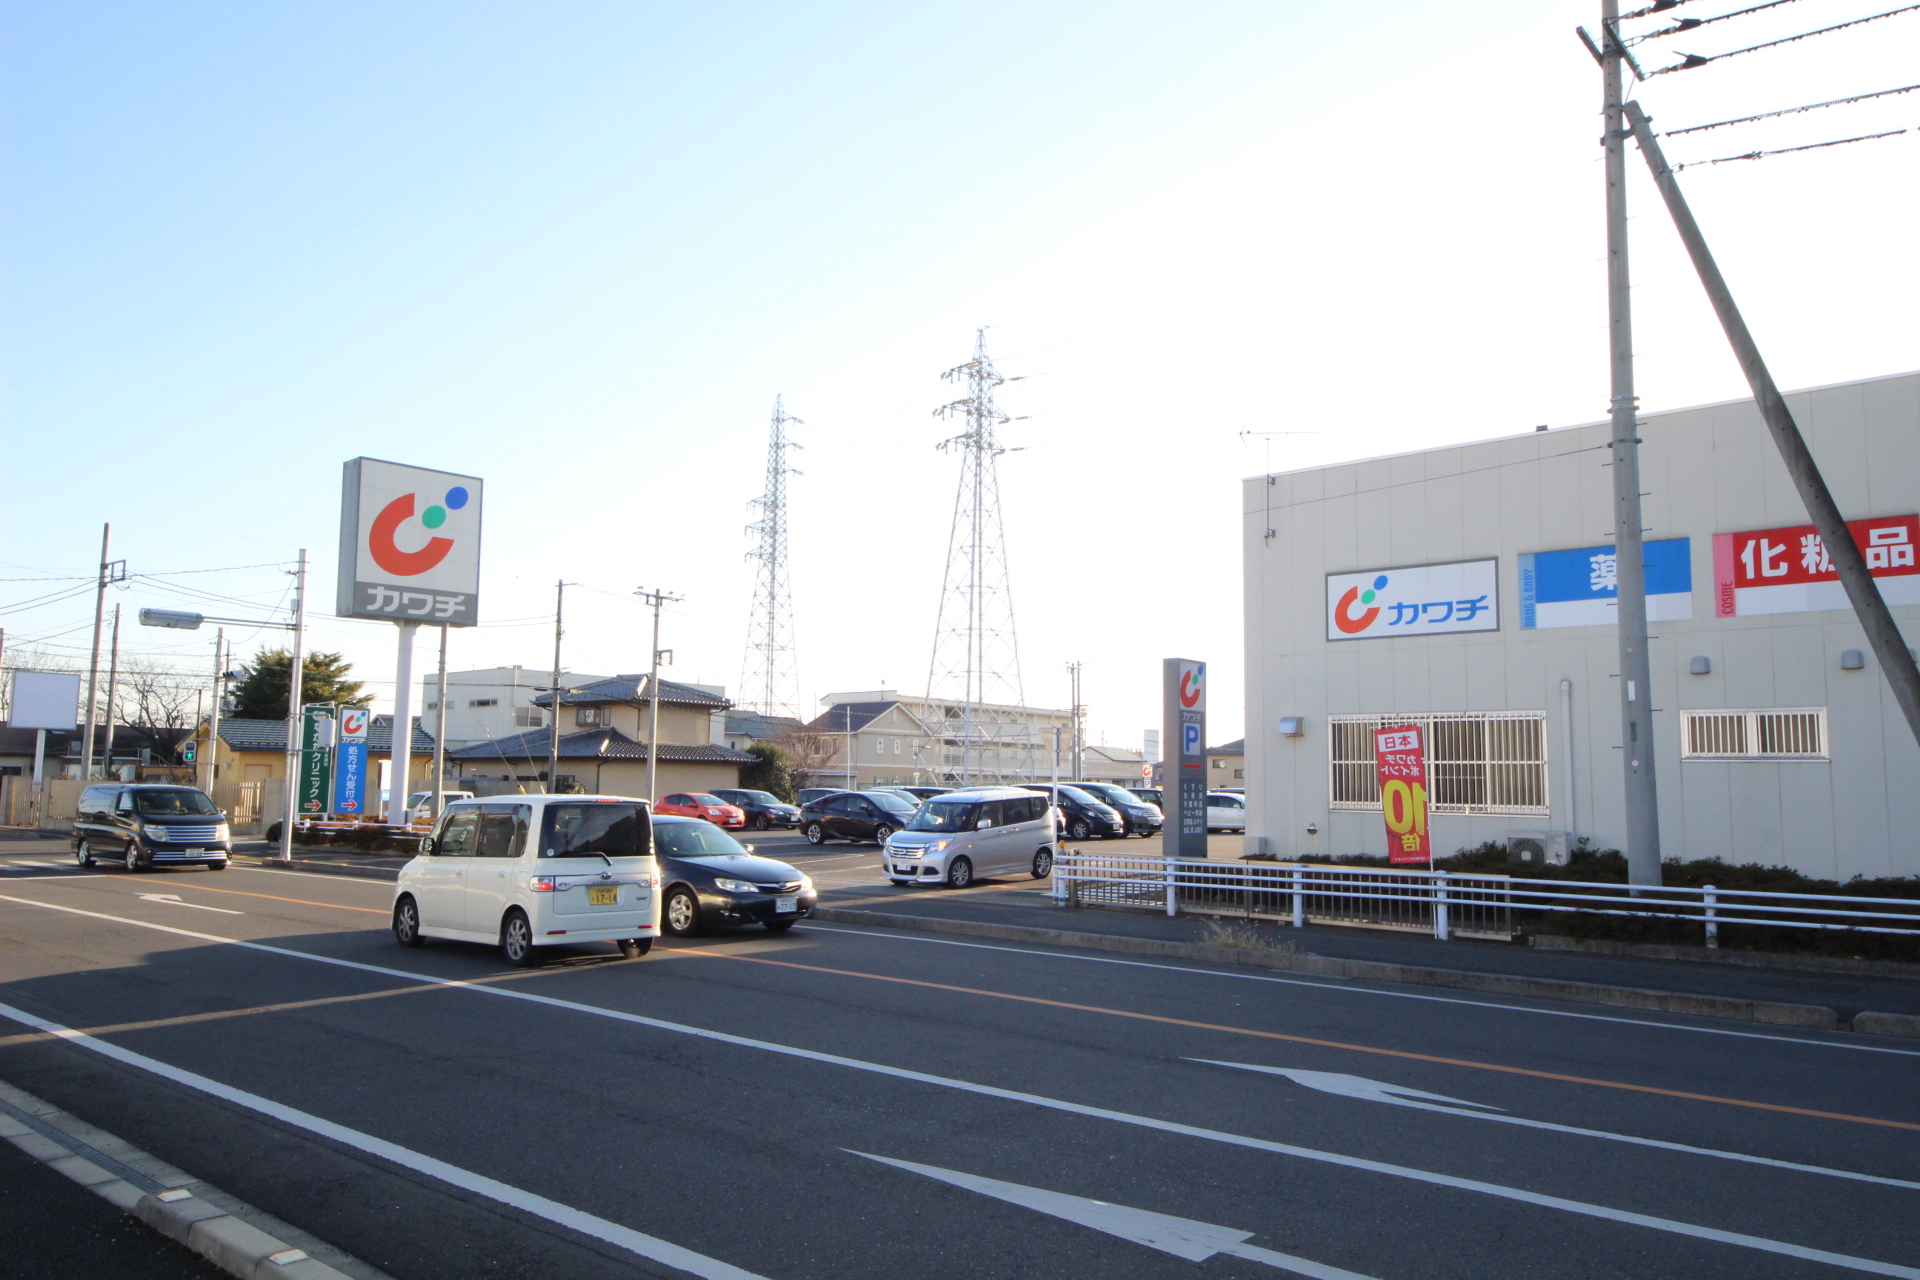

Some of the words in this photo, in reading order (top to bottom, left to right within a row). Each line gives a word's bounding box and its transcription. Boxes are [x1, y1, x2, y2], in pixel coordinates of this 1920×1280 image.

[1522, 569, 1534, 592] BABY
[366, 586, 466, 618] カワチ
[1388, 595, 1489, 626] カワチ
[1720, 580, 1734, 615] COSME
[1524, 602, 1535, 628] DRUG
[1182, 711, 1202, 722] カワチ
[341, 736, 366, 744] カワチ
[1185, 725, 1199, 752] P
[345, 745, 359, 799] 処方せん受付
